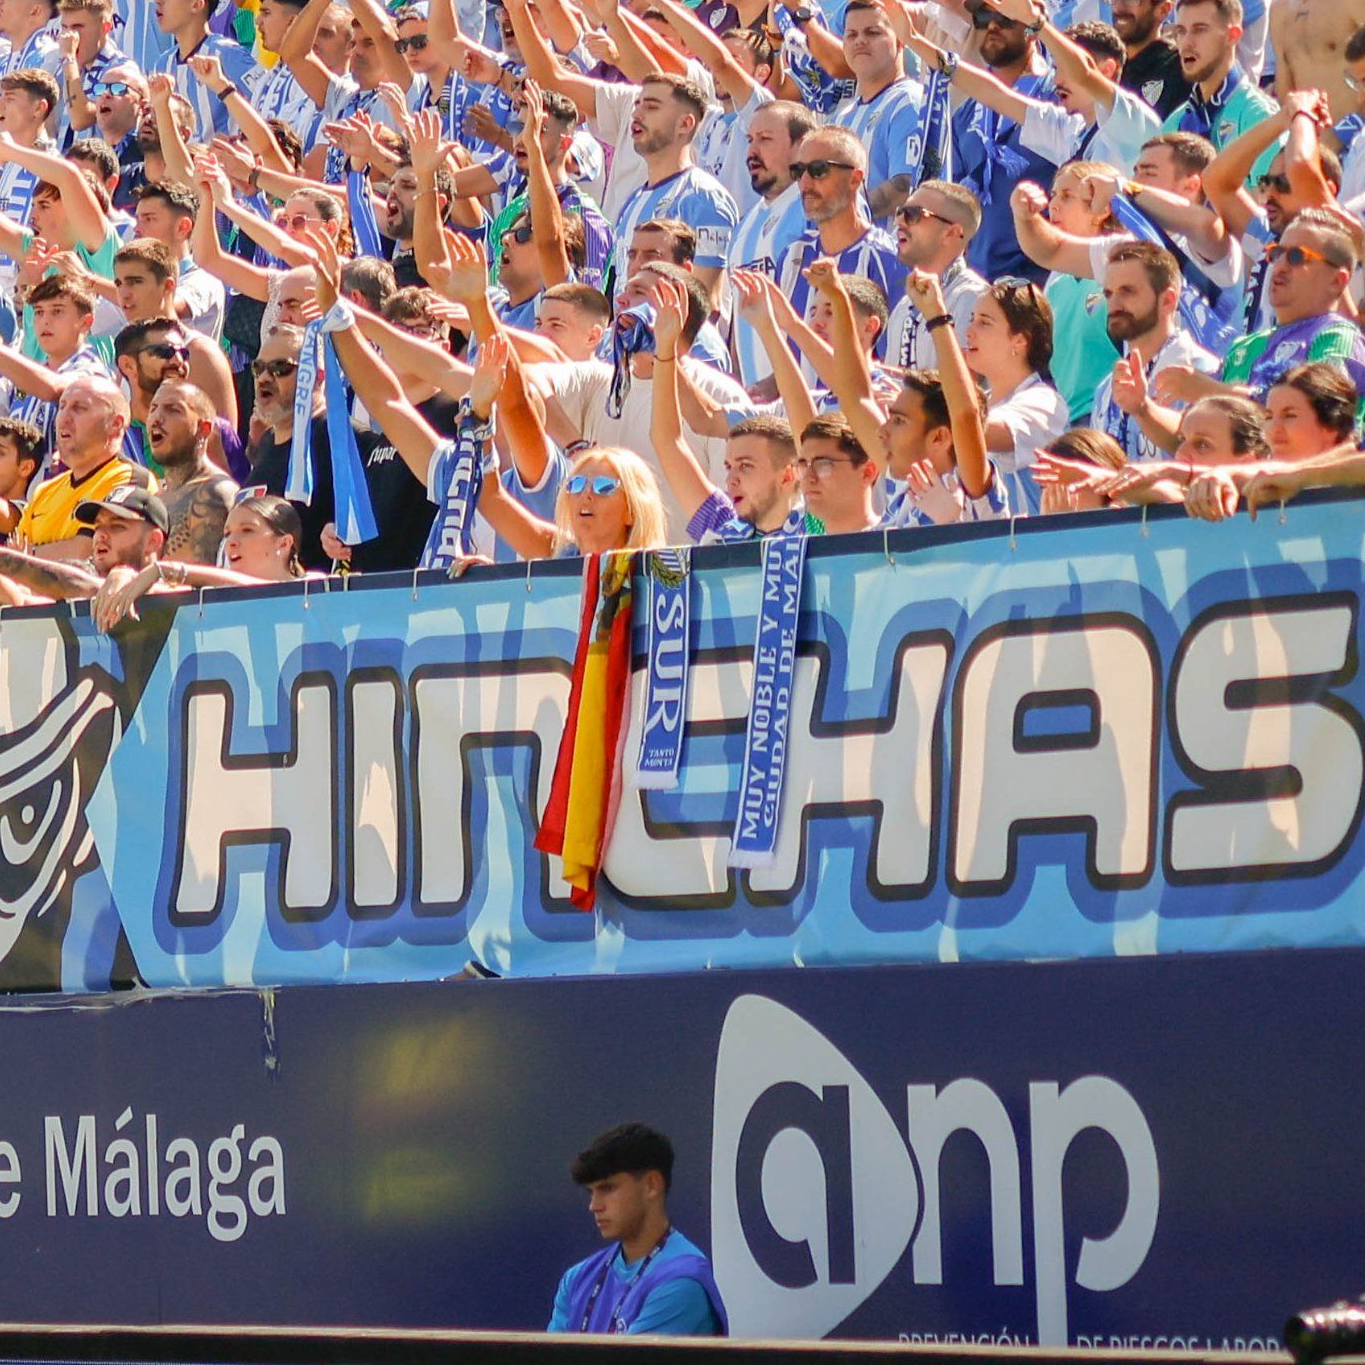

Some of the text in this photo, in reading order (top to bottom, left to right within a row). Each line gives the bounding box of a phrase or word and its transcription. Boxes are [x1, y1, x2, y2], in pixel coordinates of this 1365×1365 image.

[644, 593, 685, 735] SUR
[762, 615, 779, 635] Y
[753, 645, 777, 753] NOBLE
[763, 686, 792, 828] CIUDAD
[778, 627, 795, 675] DE
[742, 764, 766, 840] MUY
[45, 1107, 286, 1241] Málaga
